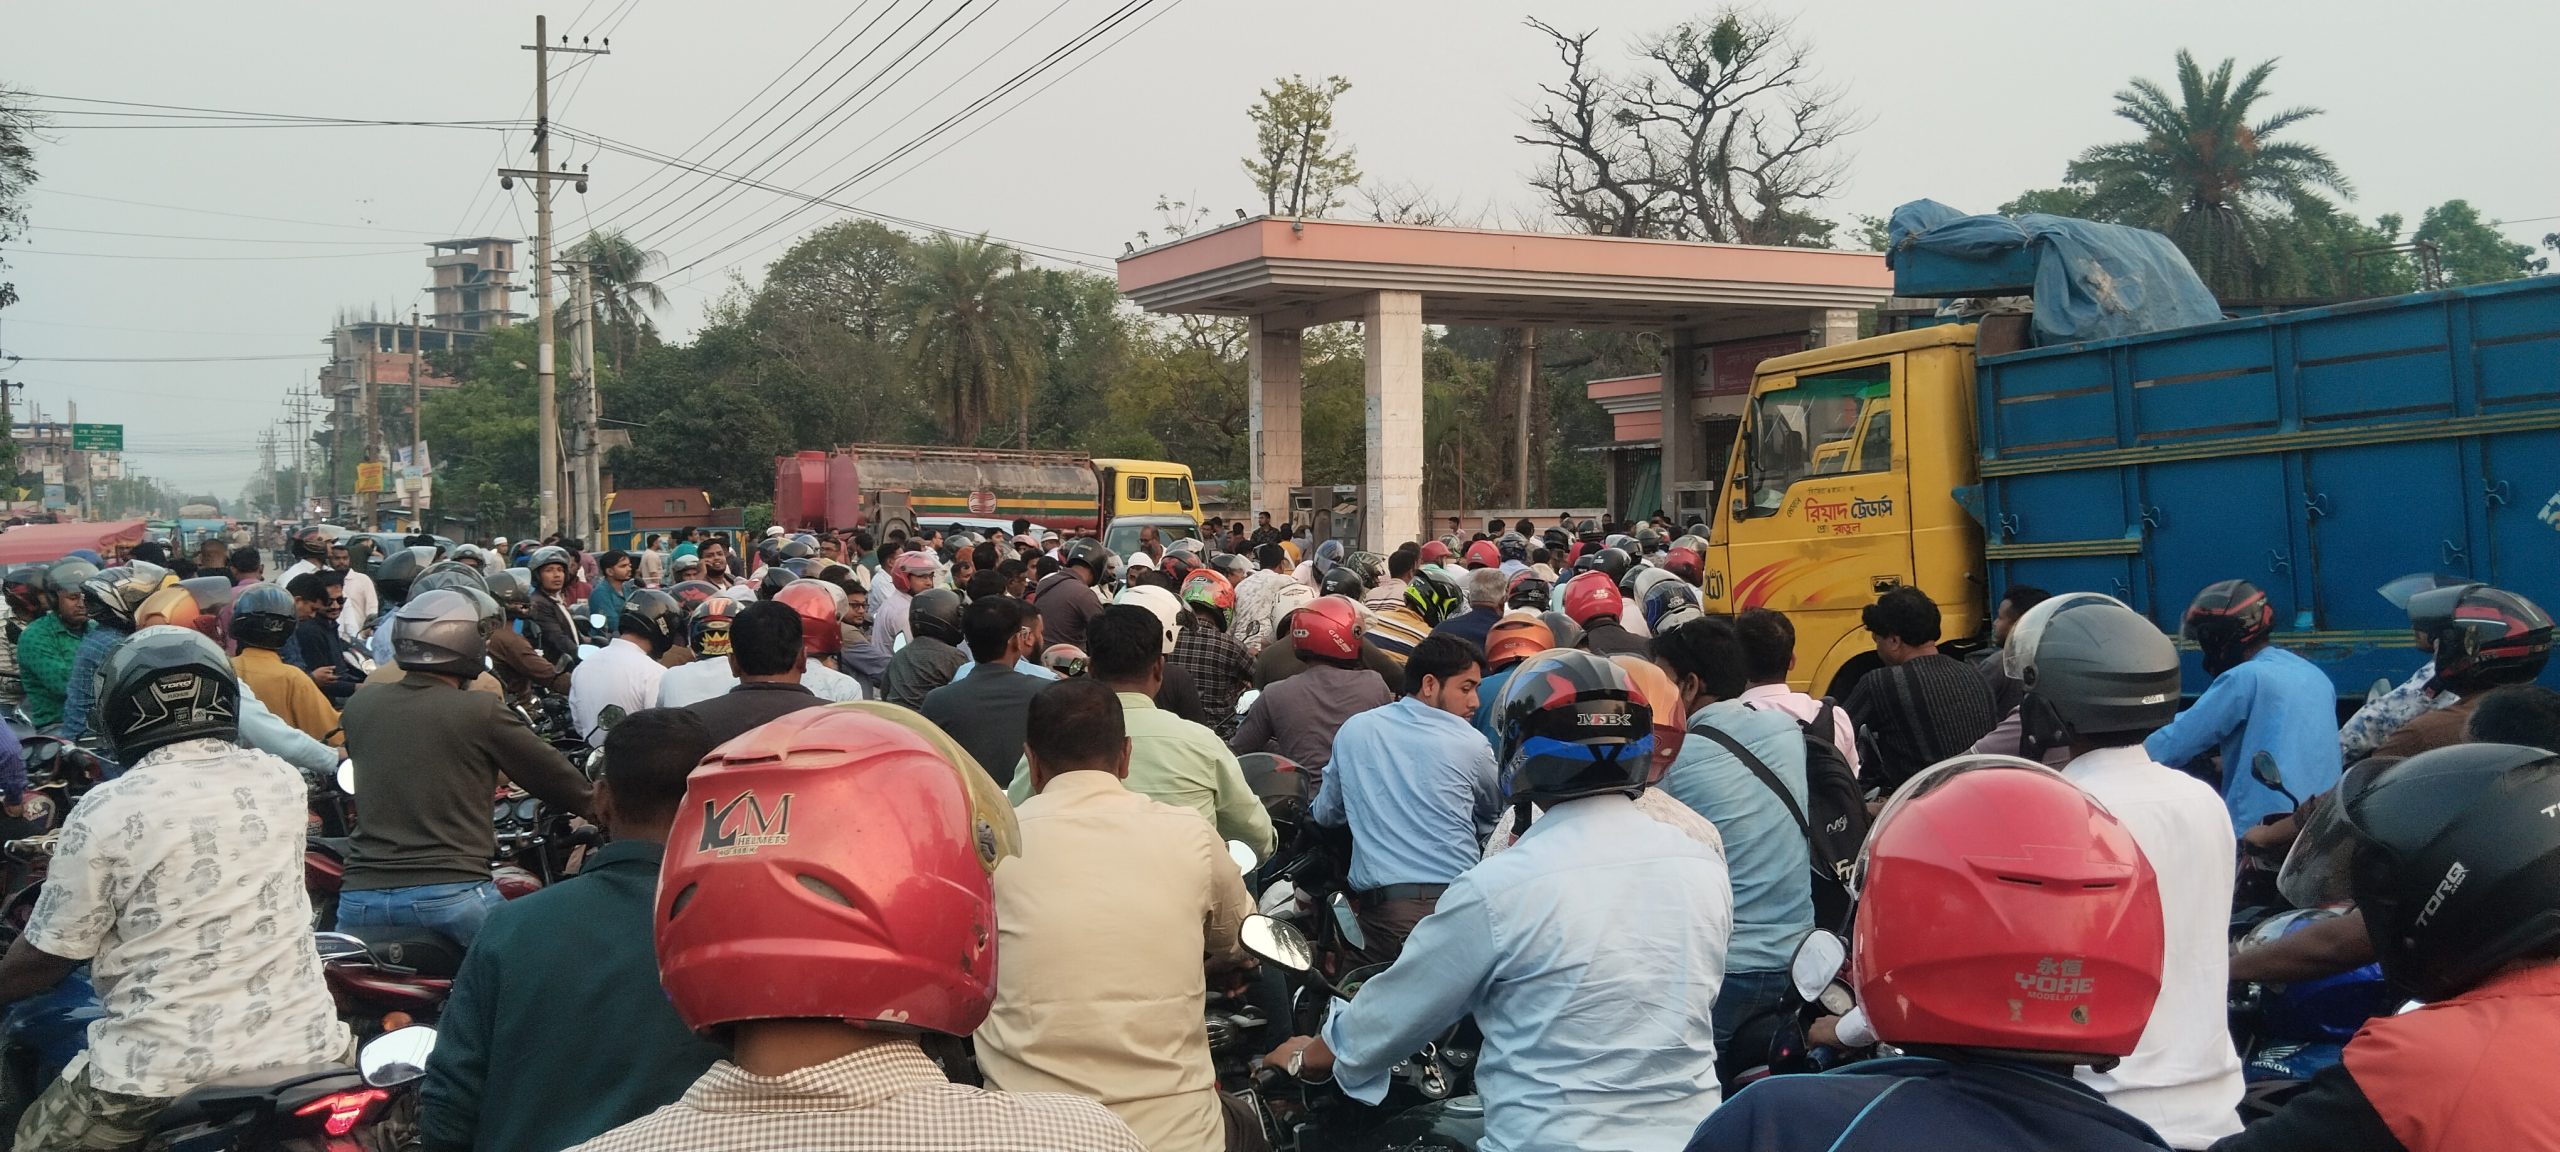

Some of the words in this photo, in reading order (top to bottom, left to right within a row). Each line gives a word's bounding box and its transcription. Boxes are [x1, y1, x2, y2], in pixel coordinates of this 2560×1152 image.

[1804, 497, 1848, 523] রিয়াদ
[1851, 495, 1893, 519] ট্রেডার্স
[2540, 802, 2560, 818] T
[698, 790, 794, 853] KM
[737, 835, 788, 846] HELMETS
[2415, 861, 2470, 927] TORQ
[2015, 972, 2095, 994] YOHE
[2251, 1061, 2291, 1074] HONDA
